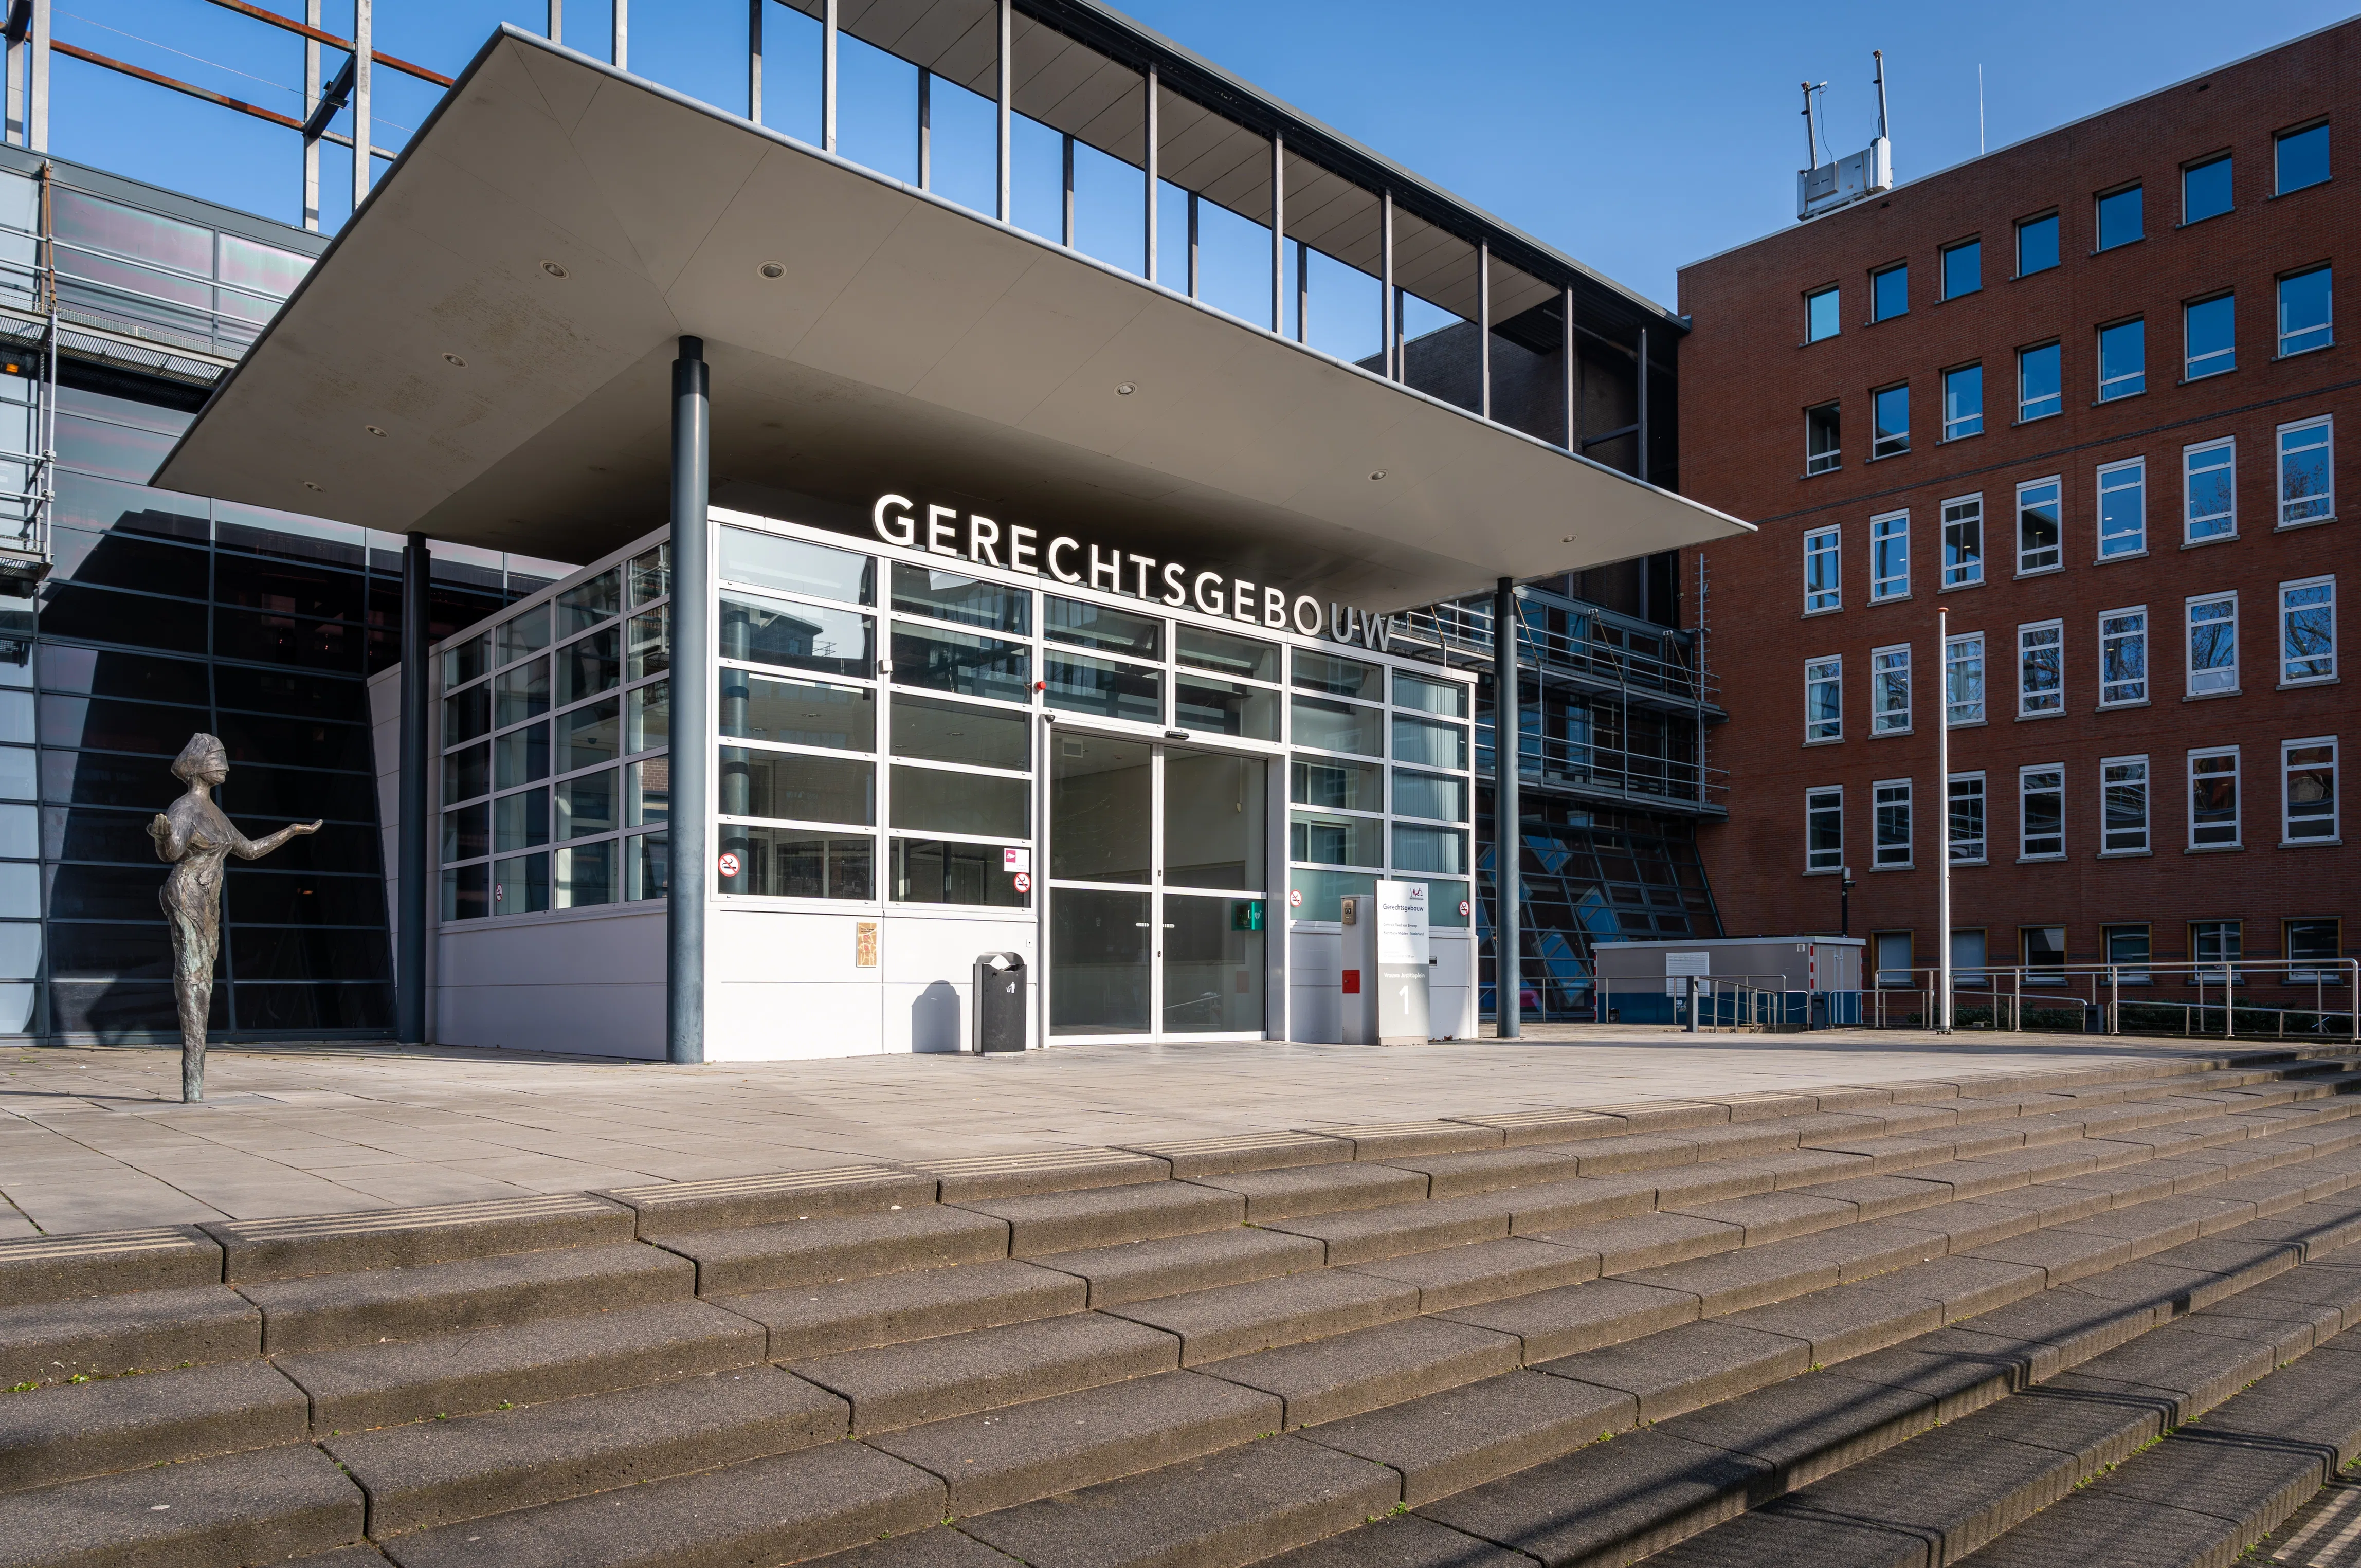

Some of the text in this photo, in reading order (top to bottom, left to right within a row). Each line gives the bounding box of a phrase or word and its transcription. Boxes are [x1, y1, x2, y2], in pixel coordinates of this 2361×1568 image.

[872, 494, 1395, 652] GERECHTSGEBOUW
[1383, 903, 1424, 913] Gerechtsgebouw
[1399, 985, 1409, 1015] 1
